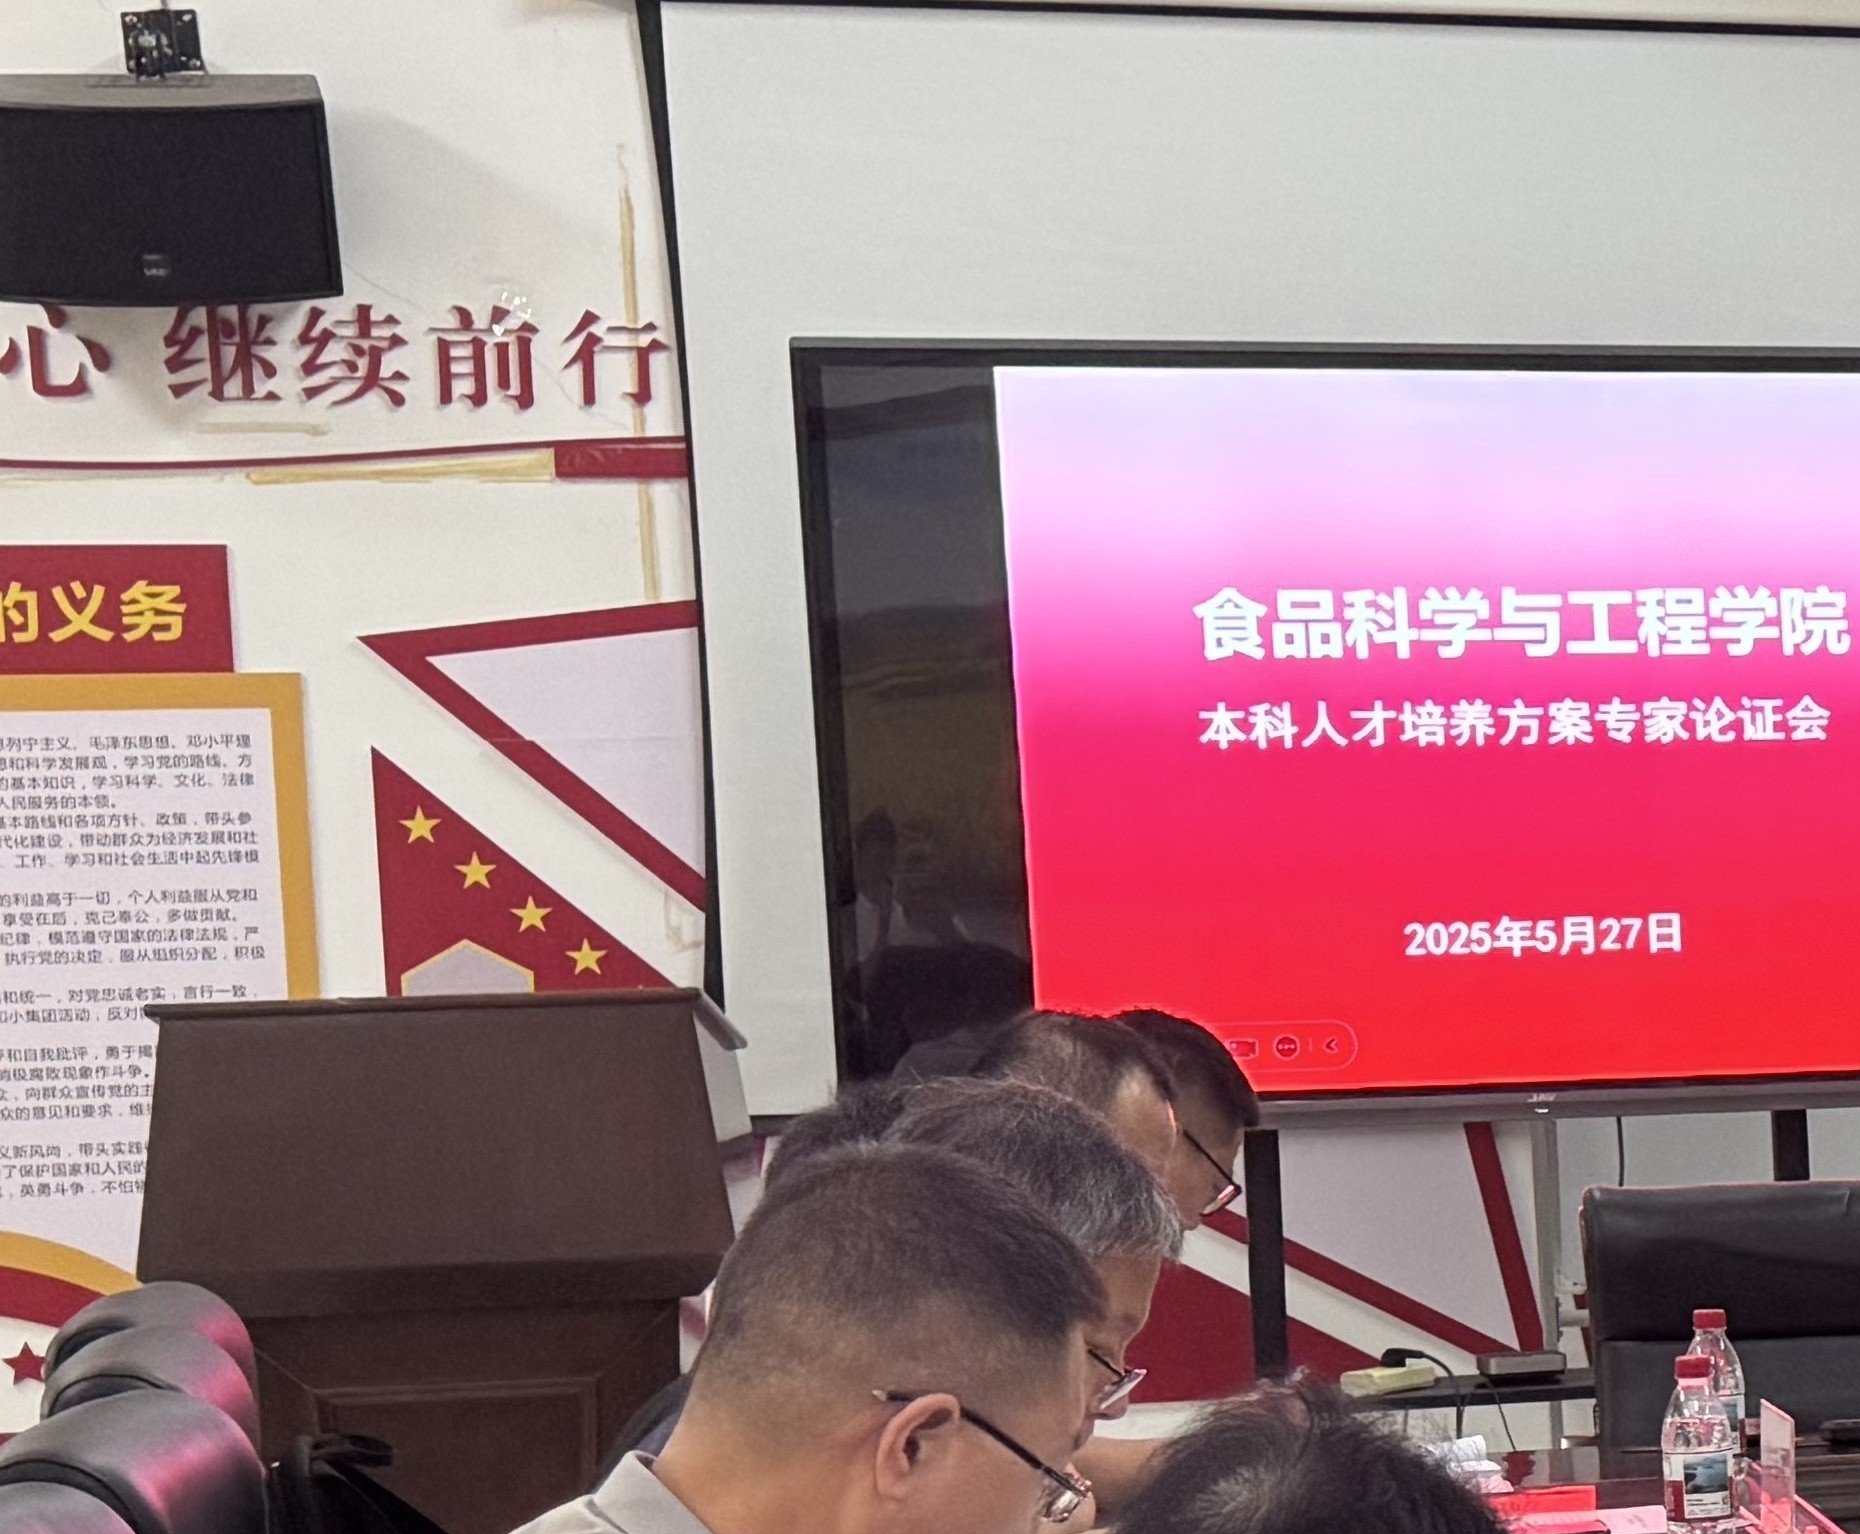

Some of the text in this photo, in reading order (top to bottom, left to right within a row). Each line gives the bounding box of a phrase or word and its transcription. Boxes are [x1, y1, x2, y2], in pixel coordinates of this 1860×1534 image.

[0, 303, 670, 411] 心 继续前行
[0, 579, 187, 644] 的义务
[1193, 585, 1852, 663] 食品科学与工程学院
[1198, 697, 1833, 751] 本科人才培养方案专家论证会
[1403, 911, 1685, 958] 2025年5月27日
